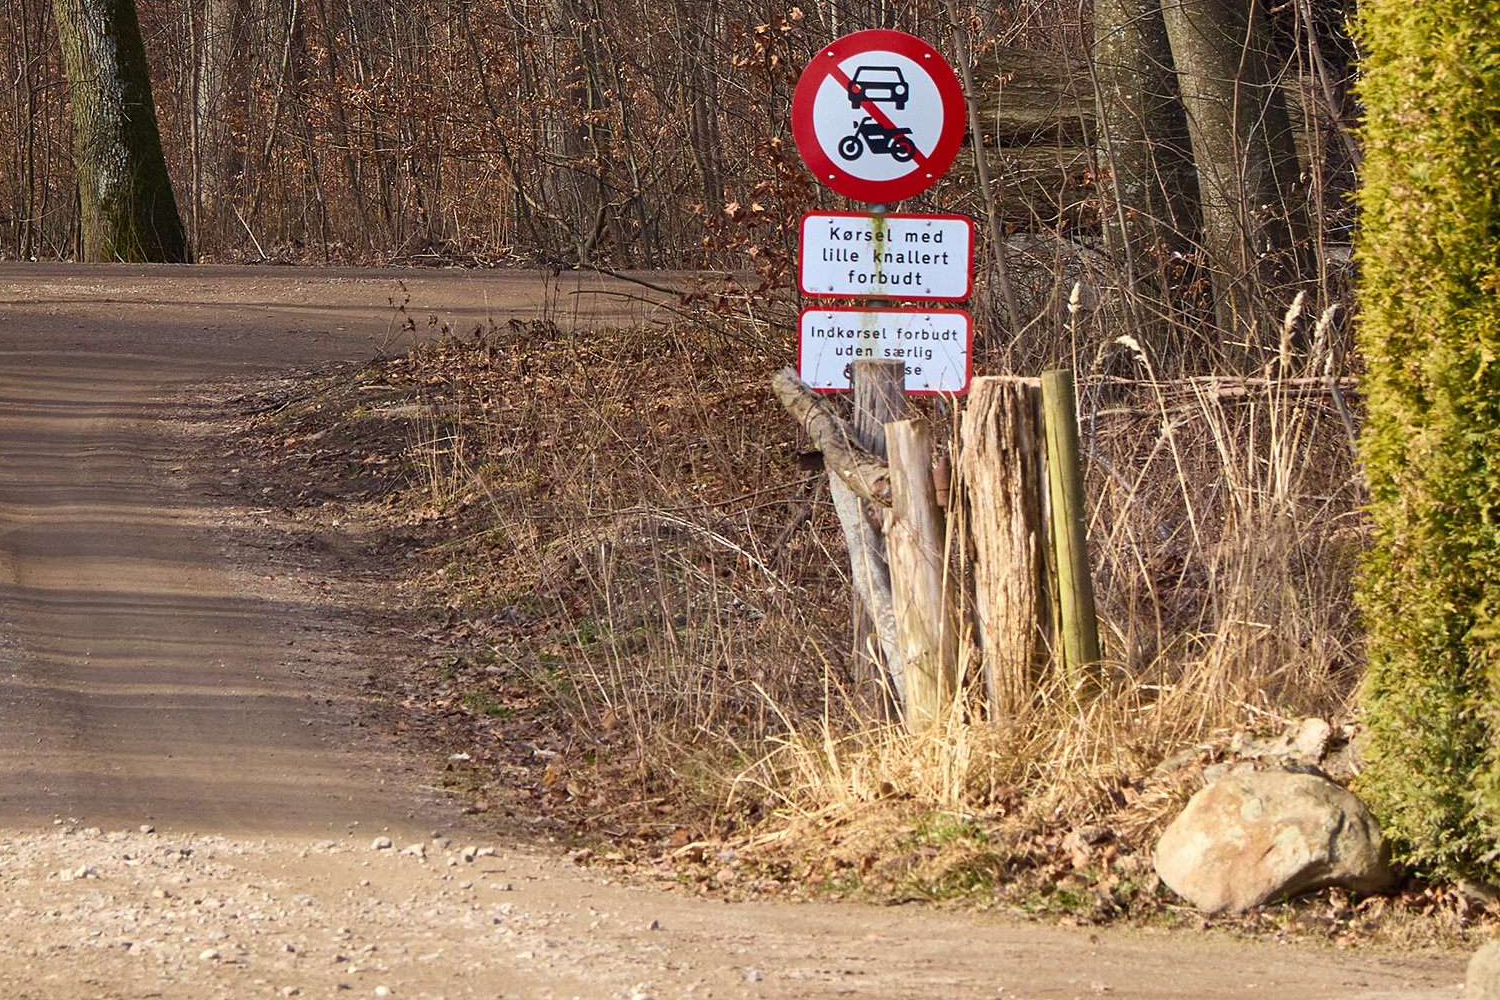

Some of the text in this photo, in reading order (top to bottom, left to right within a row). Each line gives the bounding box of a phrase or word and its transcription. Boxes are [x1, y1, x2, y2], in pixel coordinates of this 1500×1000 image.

[829, 227, 943, 243] Kørsel med
[822, 248, 949, 265] lille knallert
[848, 270, 922, 285] forbudt
[811, 326, 958, 341] Indkørsel forbudt
[835, 345, 932, 360] uden særlig
